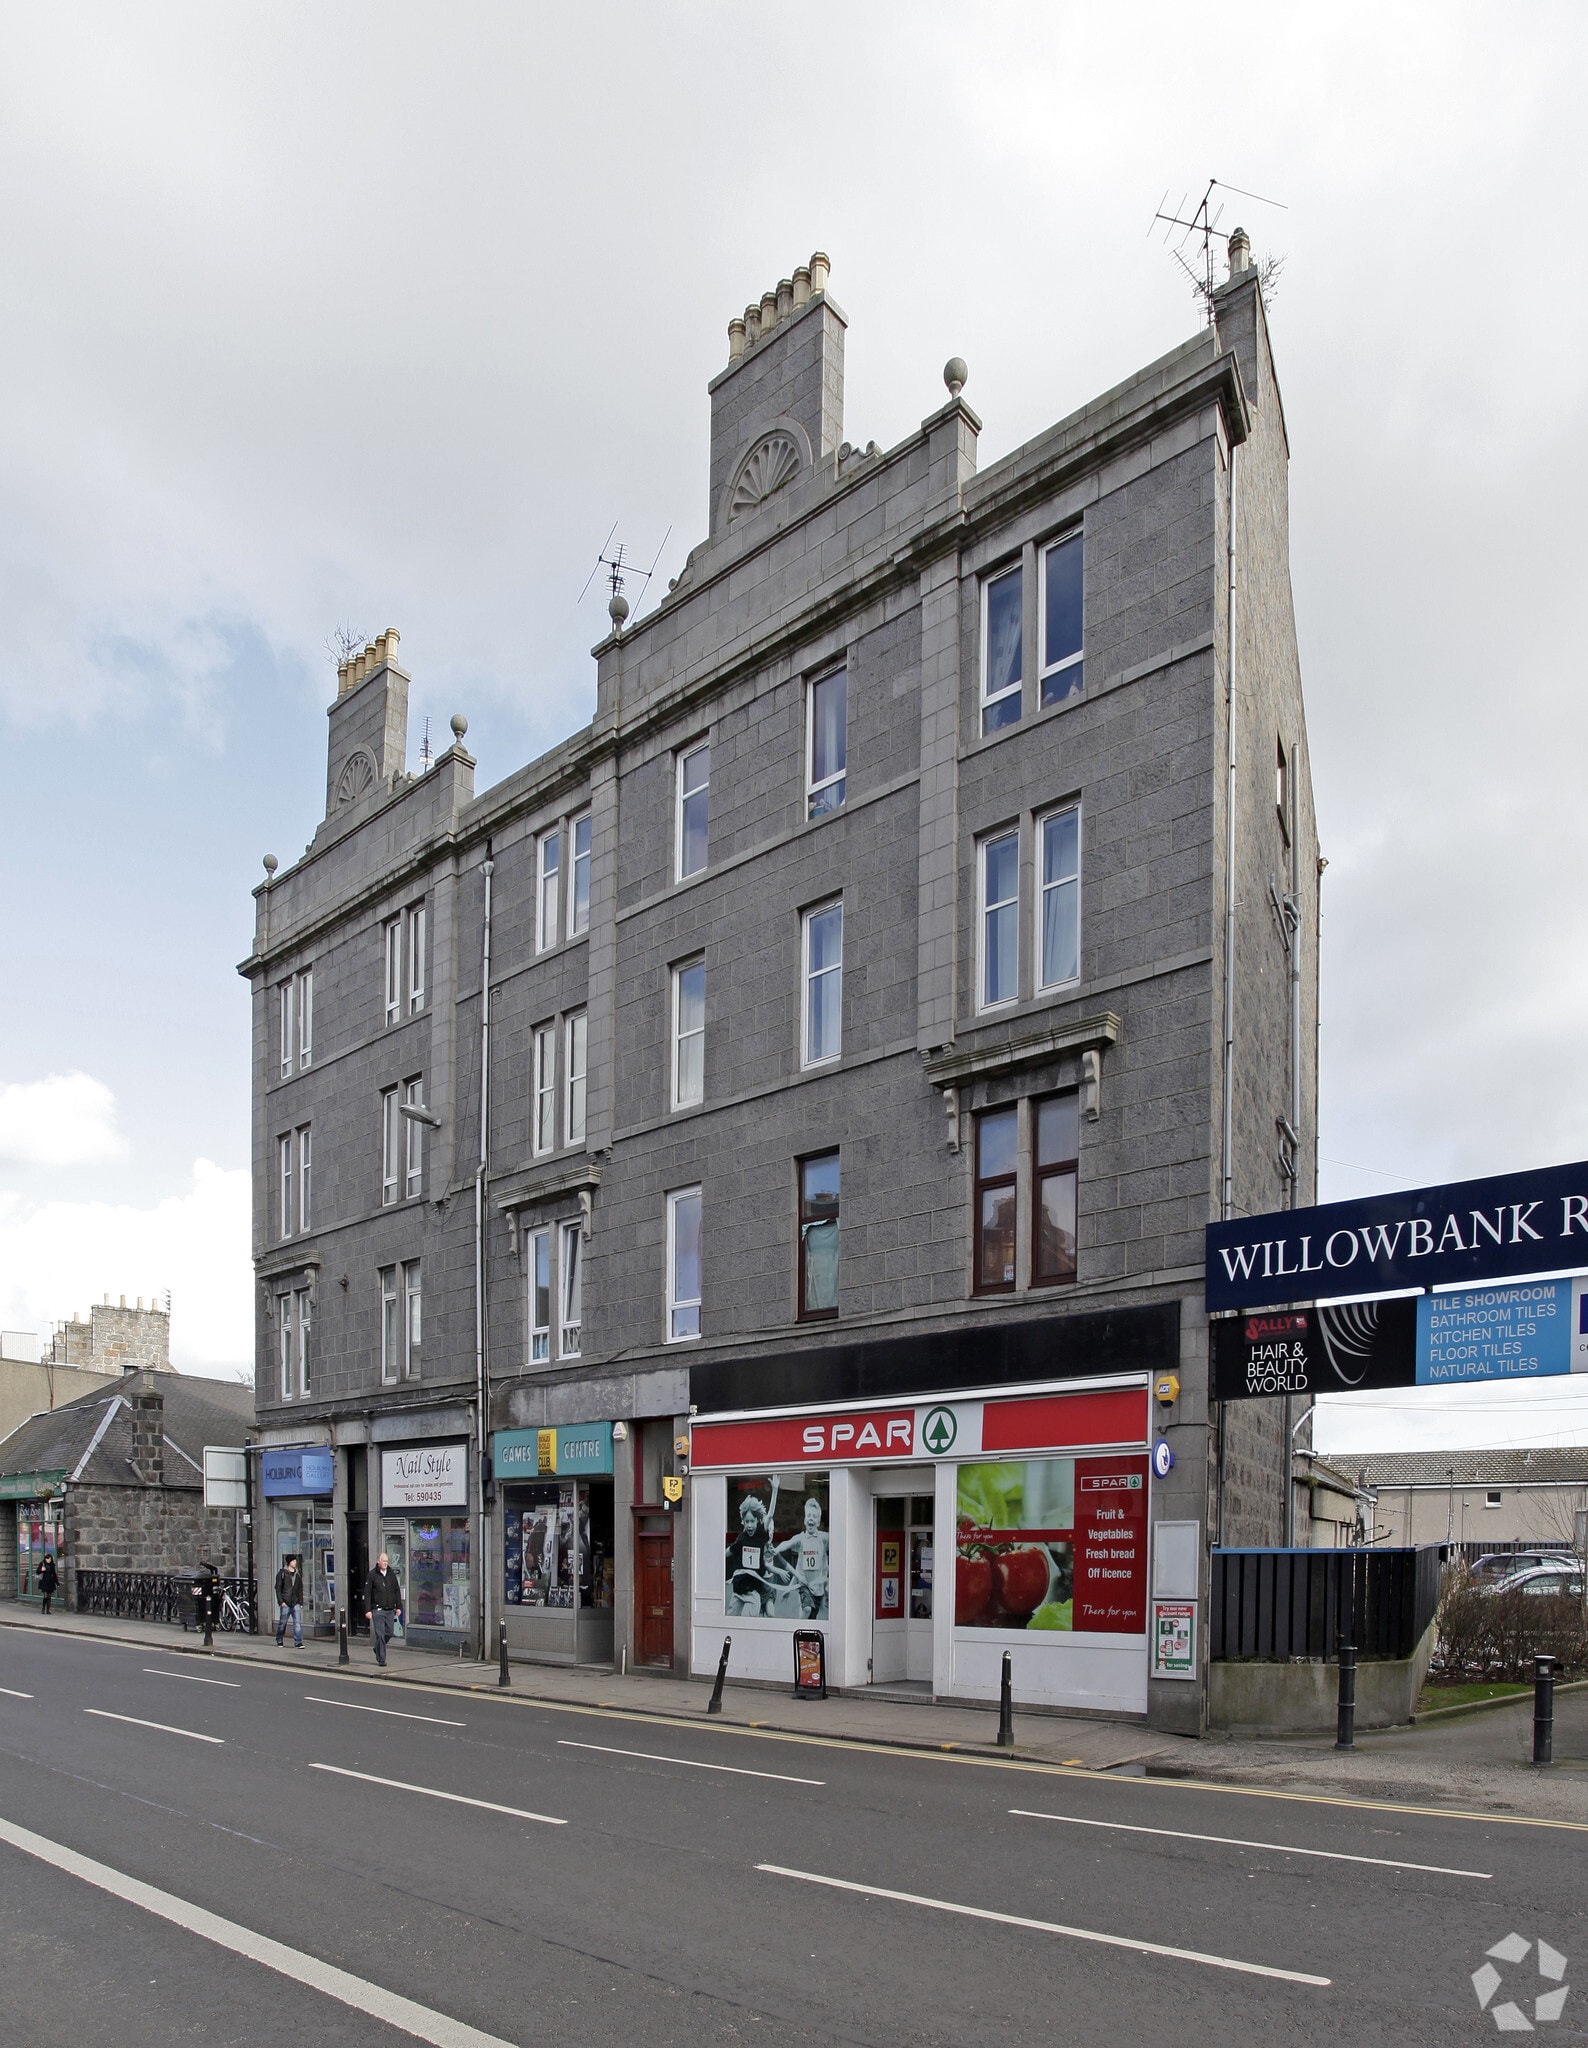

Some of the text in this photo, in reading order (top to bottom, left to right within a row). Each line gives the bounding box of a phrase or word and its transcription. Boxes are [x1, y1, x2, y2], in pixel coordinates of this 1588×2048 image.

[1218, 1200, 1544, 1282] WILLOWBANK
[1431, 1286, 1556, 1311] TILE SHOWROOM
[1430, 1303, 1557, 1329] BATHROOM TILES
[1430, 1322, 1537, 1345] KITCHEN TILES
[1251, 1341, 1304, 1361] HAIR &
[1430, 1341, 1522, 1362] FLOOR TILES
[1247, 1357, 1308, 1378] BEAUTY
[1429, 1357, 1539, 1379] NATURAL TILES
[1159, 1384, 1170, 1393] ADT
[1245, 1374, 1308, 1393] WORLD
[802, 1419, 911, 1453] SPAR
[502, 1439, 600, 1463] GAMES CENTRE
[396, 1450, 451, 1480] Nail Style
[538, 1456, 551, 1468] CLUB
[265, 1466, 296, 1480] HOLBURN
[1092, 1478, 1127, 1488] SPAR
[405, 1491, 442, 1502] Tel: 590435
[1096, 1509, 1125, 1520] Fruit &
[956, 1531, 971, 1540] There
[973, 1532, 982, 1541] for
[1088, 1528, 1134, 1541] Vegetables
[748, 1555, 753, 1565] 1
[806, 1556, 816, 1568] 10
[1086, 1548, 1135, 1559] Fresh bread
[1088, 1567, 1132, 1579] Off licence
[1082, 1604, 1137, 1621] There for you
